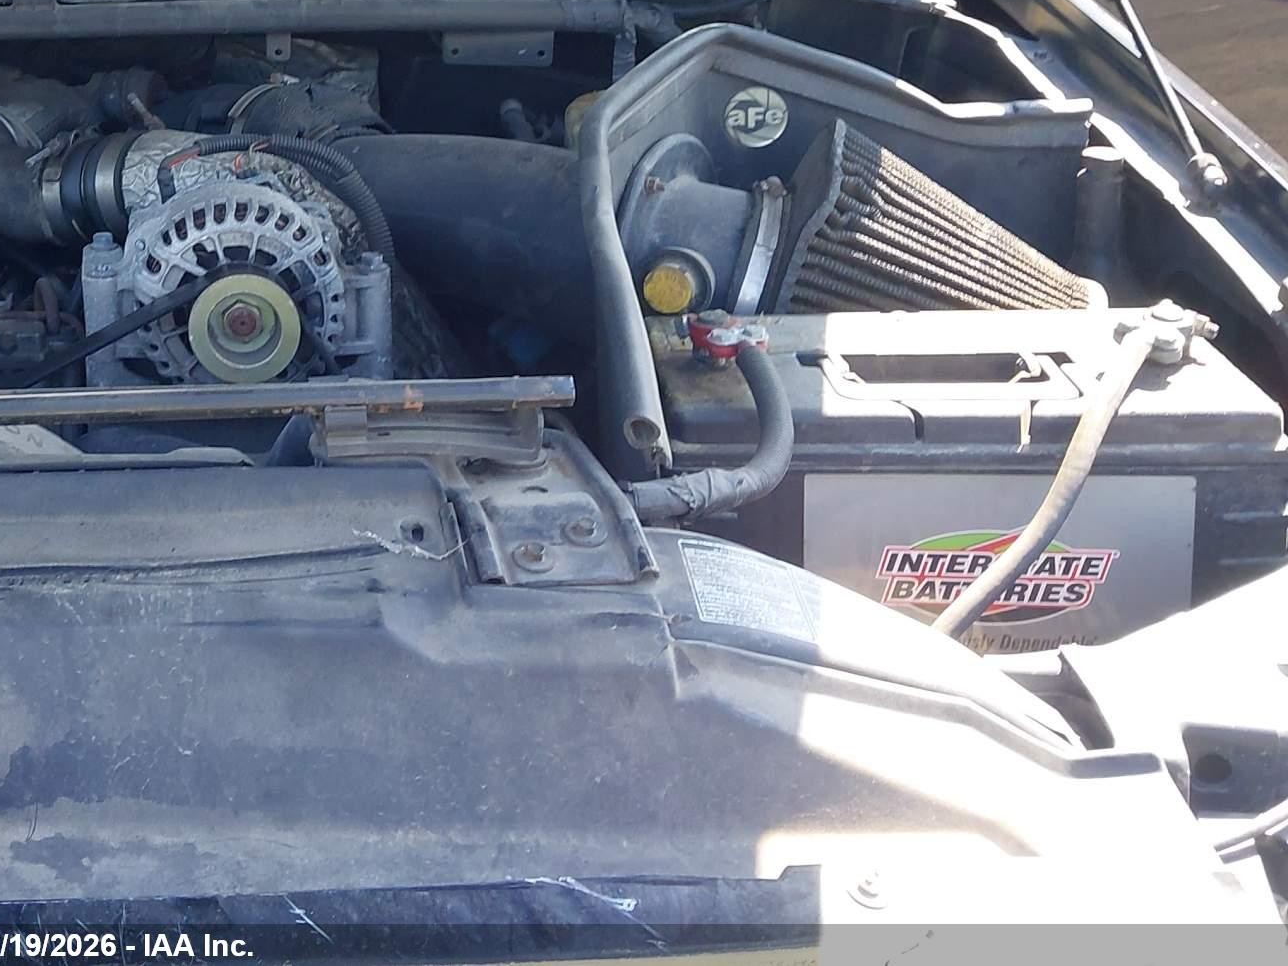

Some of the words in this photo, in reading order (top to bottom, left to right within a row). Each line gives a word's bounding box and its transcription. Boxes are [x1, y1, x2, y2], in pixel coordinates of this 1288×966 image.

[727, 106, 785, 129] aFe
[885, 552, 1104, 576] INTERATE
[891, 580, 1088, 603] BATRIES
